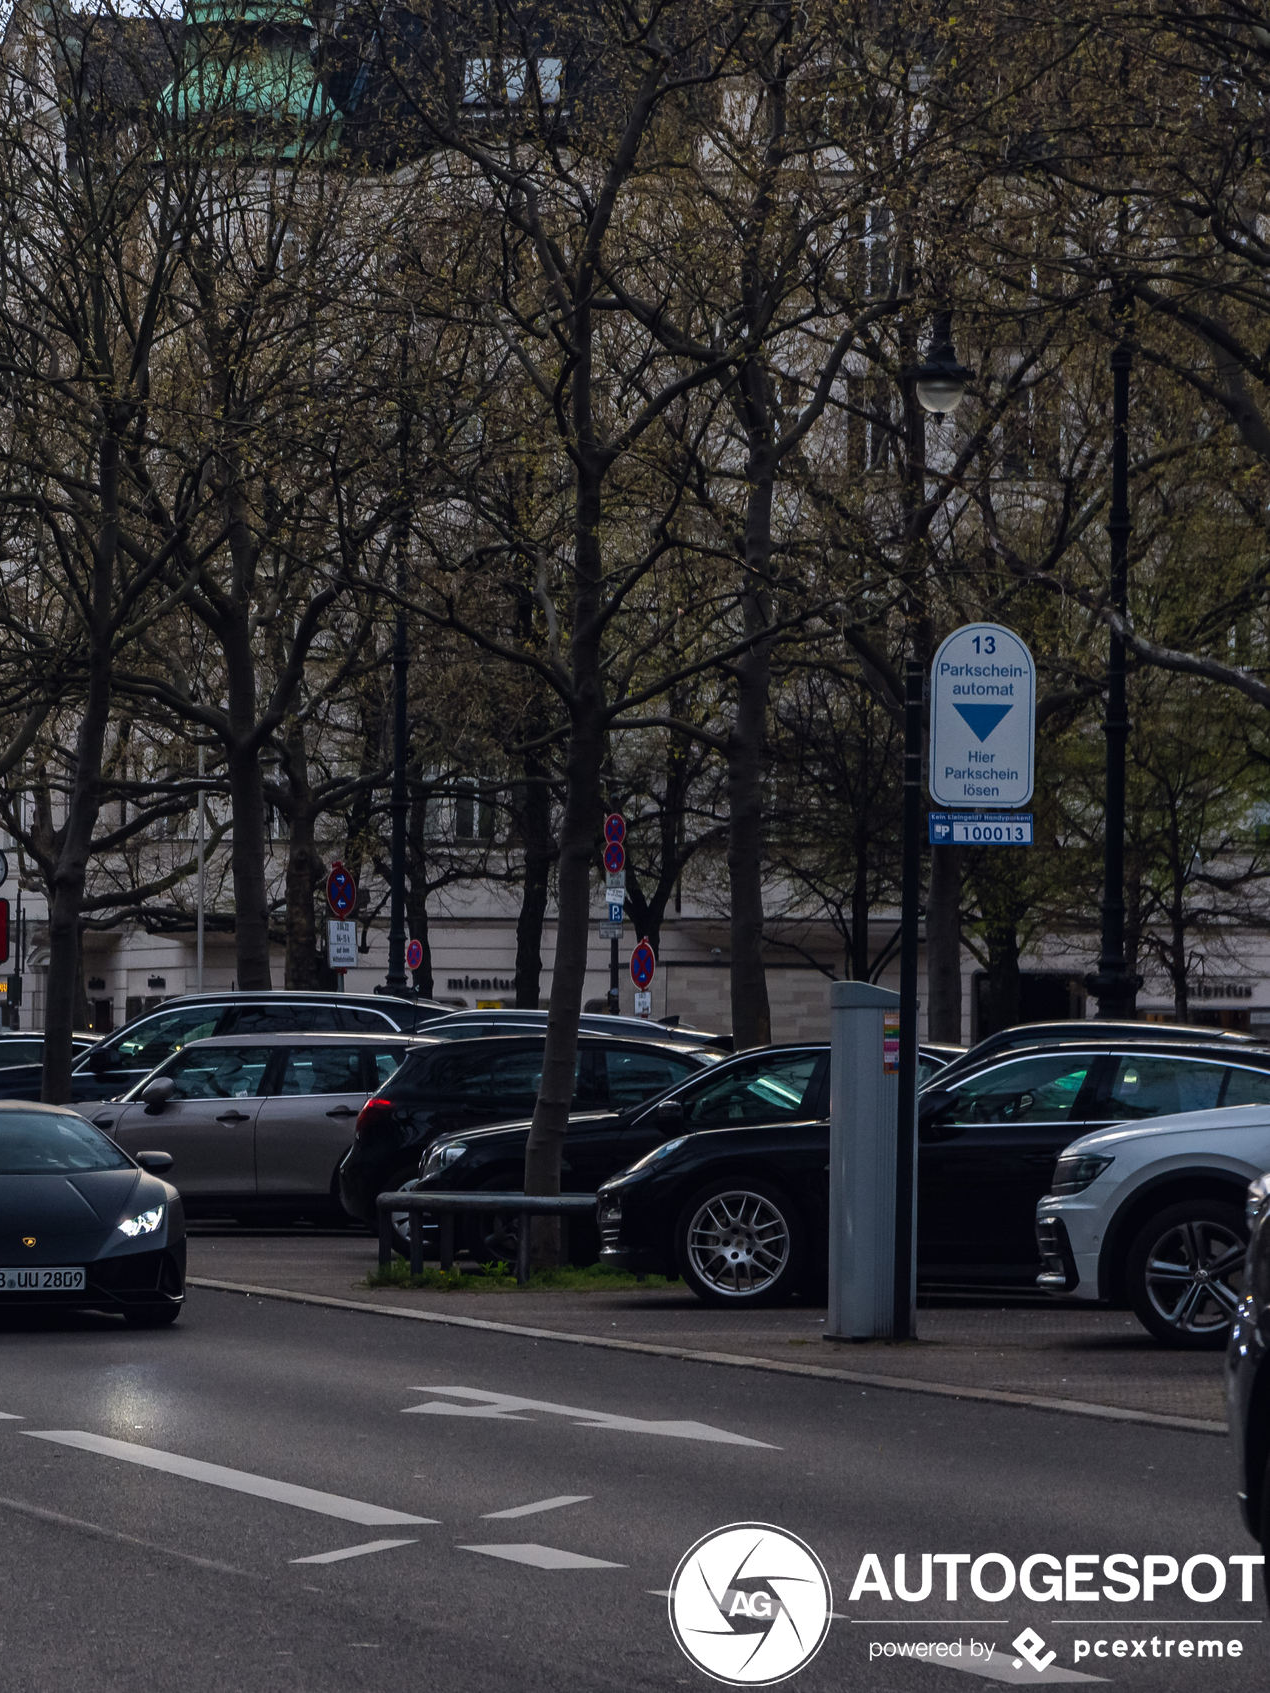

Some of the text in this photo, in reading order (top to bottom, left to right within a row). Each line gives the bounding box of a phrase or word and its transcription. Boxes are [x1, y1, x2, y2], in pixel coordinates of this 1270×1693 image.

[972, 636, 996, 654] 13
[940, 663, 1028, 677] Parkschein-
[953, 683, 1014, 696] automat
[968, 751, 995, 763] Hier
[945, 767, 1018, 780] Parkschein
[964, 784, 999, 796] lösen
[984, 814, 1031, 822] Handyparken!
[963, 826, 1024, 841] 100013
[18, 1272, 39, 1288] UU
[43, 1272, 83, 1288] 2809
